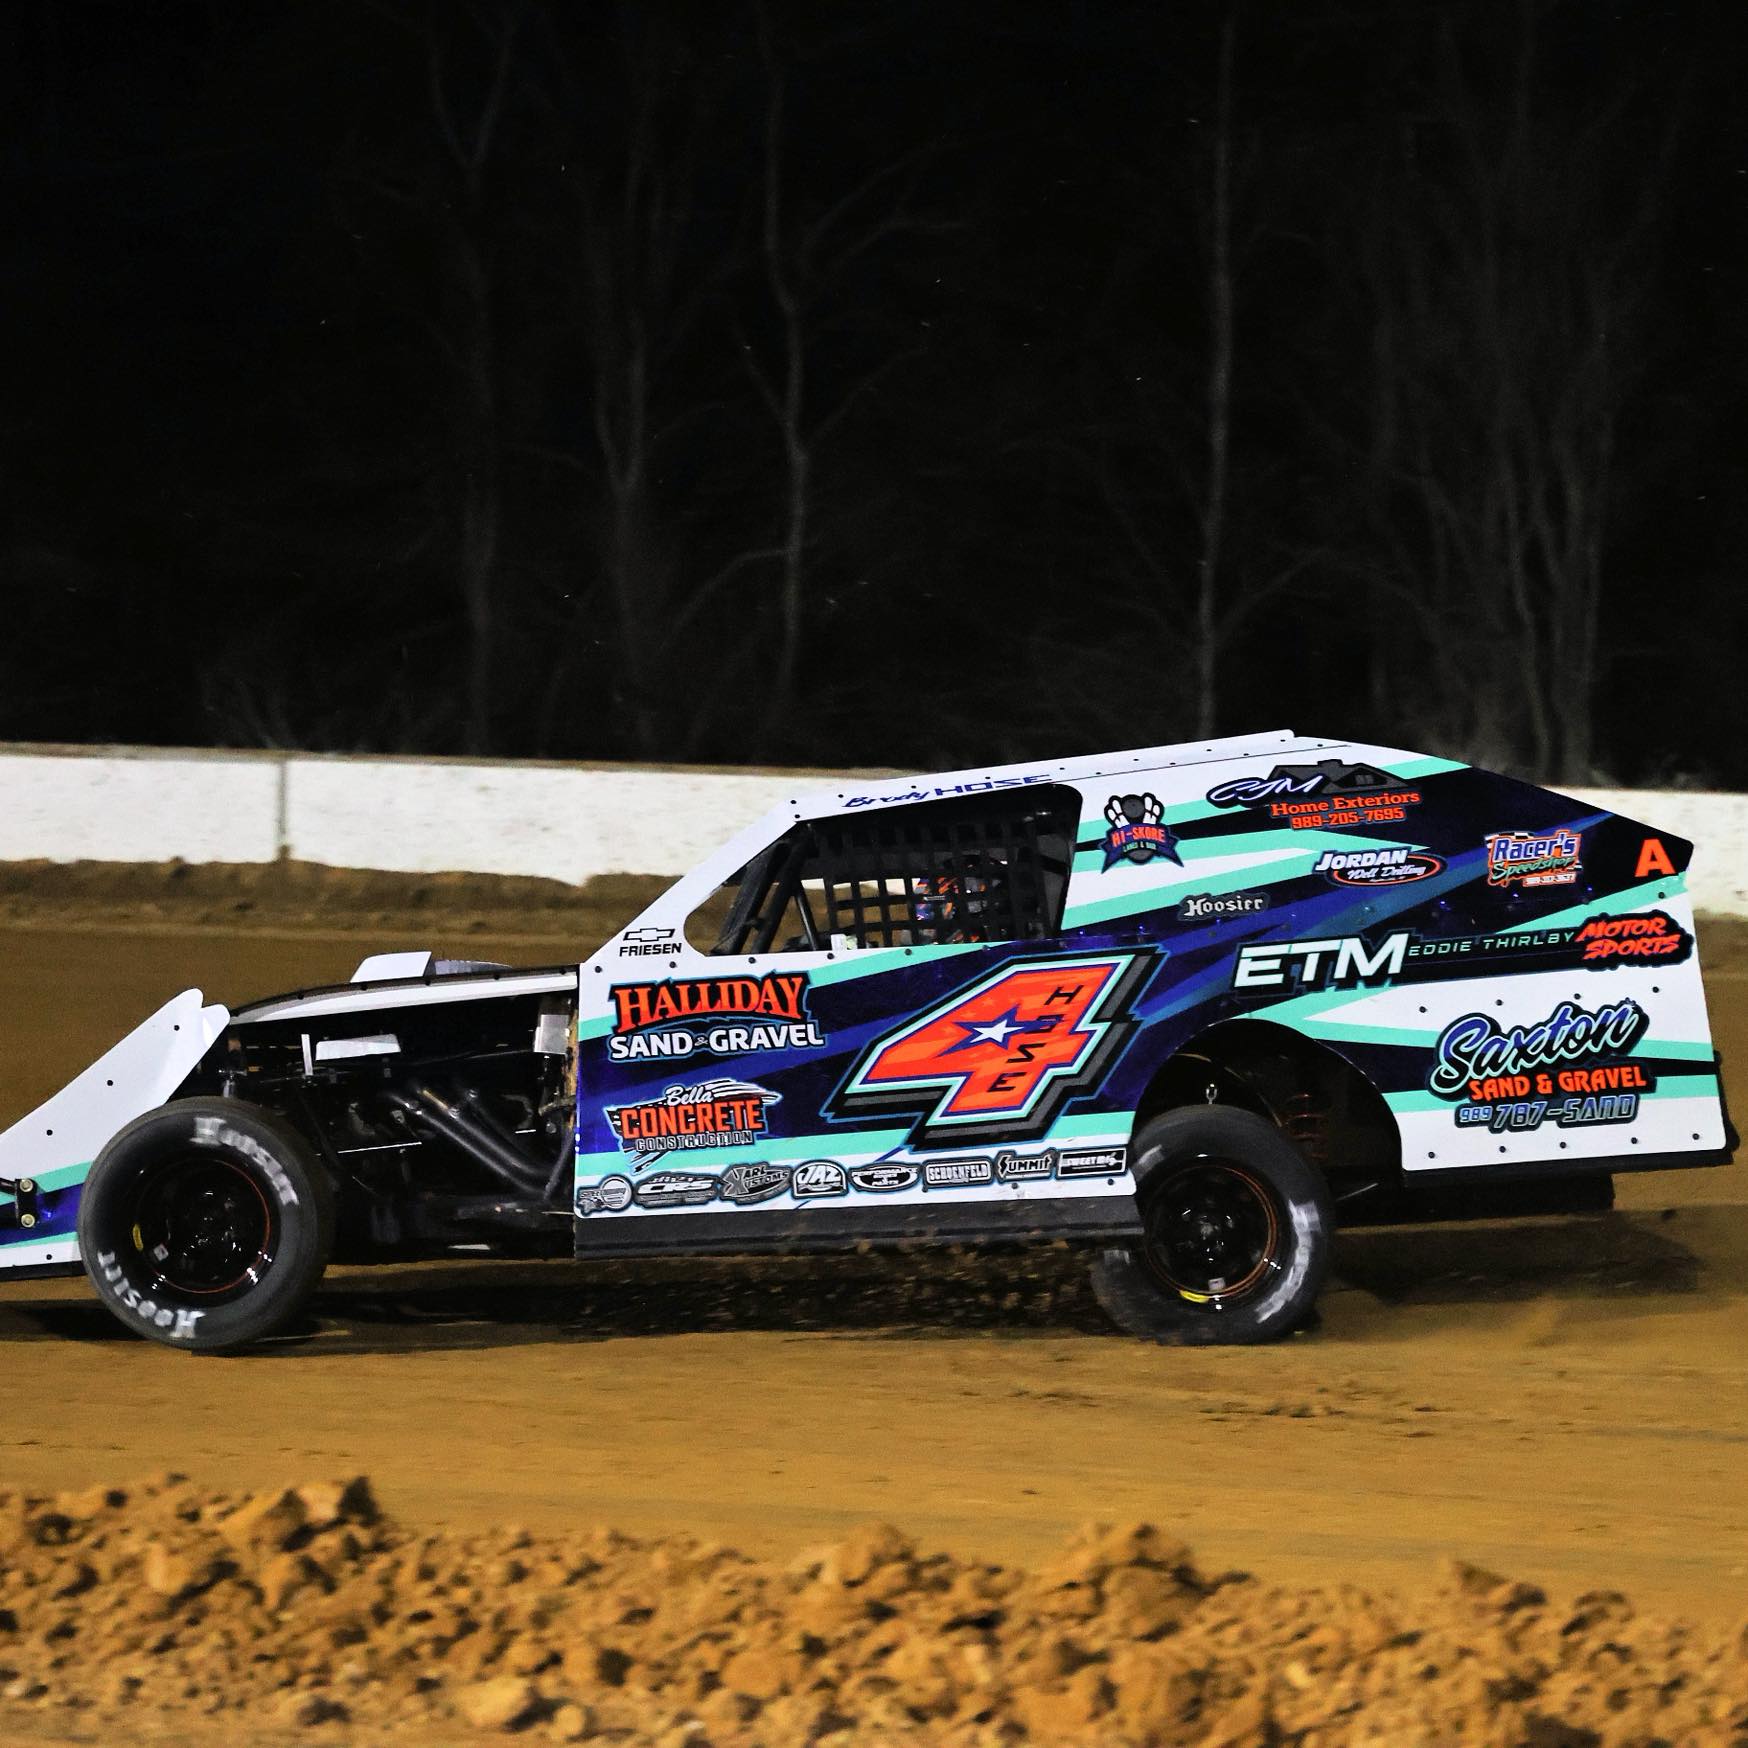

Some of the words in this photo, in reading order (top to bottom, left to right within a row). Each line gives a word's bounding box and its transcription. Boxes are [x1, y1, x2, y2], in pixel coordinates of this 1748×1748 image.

[842, 792, 929, 807] Brody
[934, 774, 1053, 796] HOSE
[1271, 799, 1329, 816] Home
[1333, 792, 1420, 808] Exteriors
[1291, 807, 1404, 829] 989-205-7695
[1315, 849, 1408, 871] JORDAN
[1493, 832, 1577, 862] Racer's
[1634, 838, 1676, 877] A
[1184, 896, 1263, 917] Hoosier
[1575, 917, 1667, 942] MOTOR
[619, 943, 682, 957] FRIESEN
[1408, 942, 1471, 957] EDDIE
[1483, 931, 1575, 950] THIRLBY
[1583, 934, 1681, 960] SPORTS
[1234, 933, 1409, 988] ETM
[614, 976, 804, 1034] HALLIDAY
[610, 1033, 693, 1059] SAND
[709, 1024, 824, 1052] GRAVEL
[845, 955, 1134, 1126] 4
[1430, 1004, 1640, 1093] Saxton
[666, 1086, 714, 1106] Bella
[1468, 1076, 1531, 1101] SAND
[1536, 1074, 1553, 1094] &
[1558, 1066, 1647, 1093] GRAVEL
[620, 1100, 765, 1139] CONCRETE
[1459, 1106, 1493, 1122] 989
[1494, 1095, 1636, 1128] 787-SAND
[636, 1130, 754, 1151] CONSTRUCTION
[797, 1165, 842, 1185] JAZ
[929, 1164, 987, 1181] SCHOENFELD
